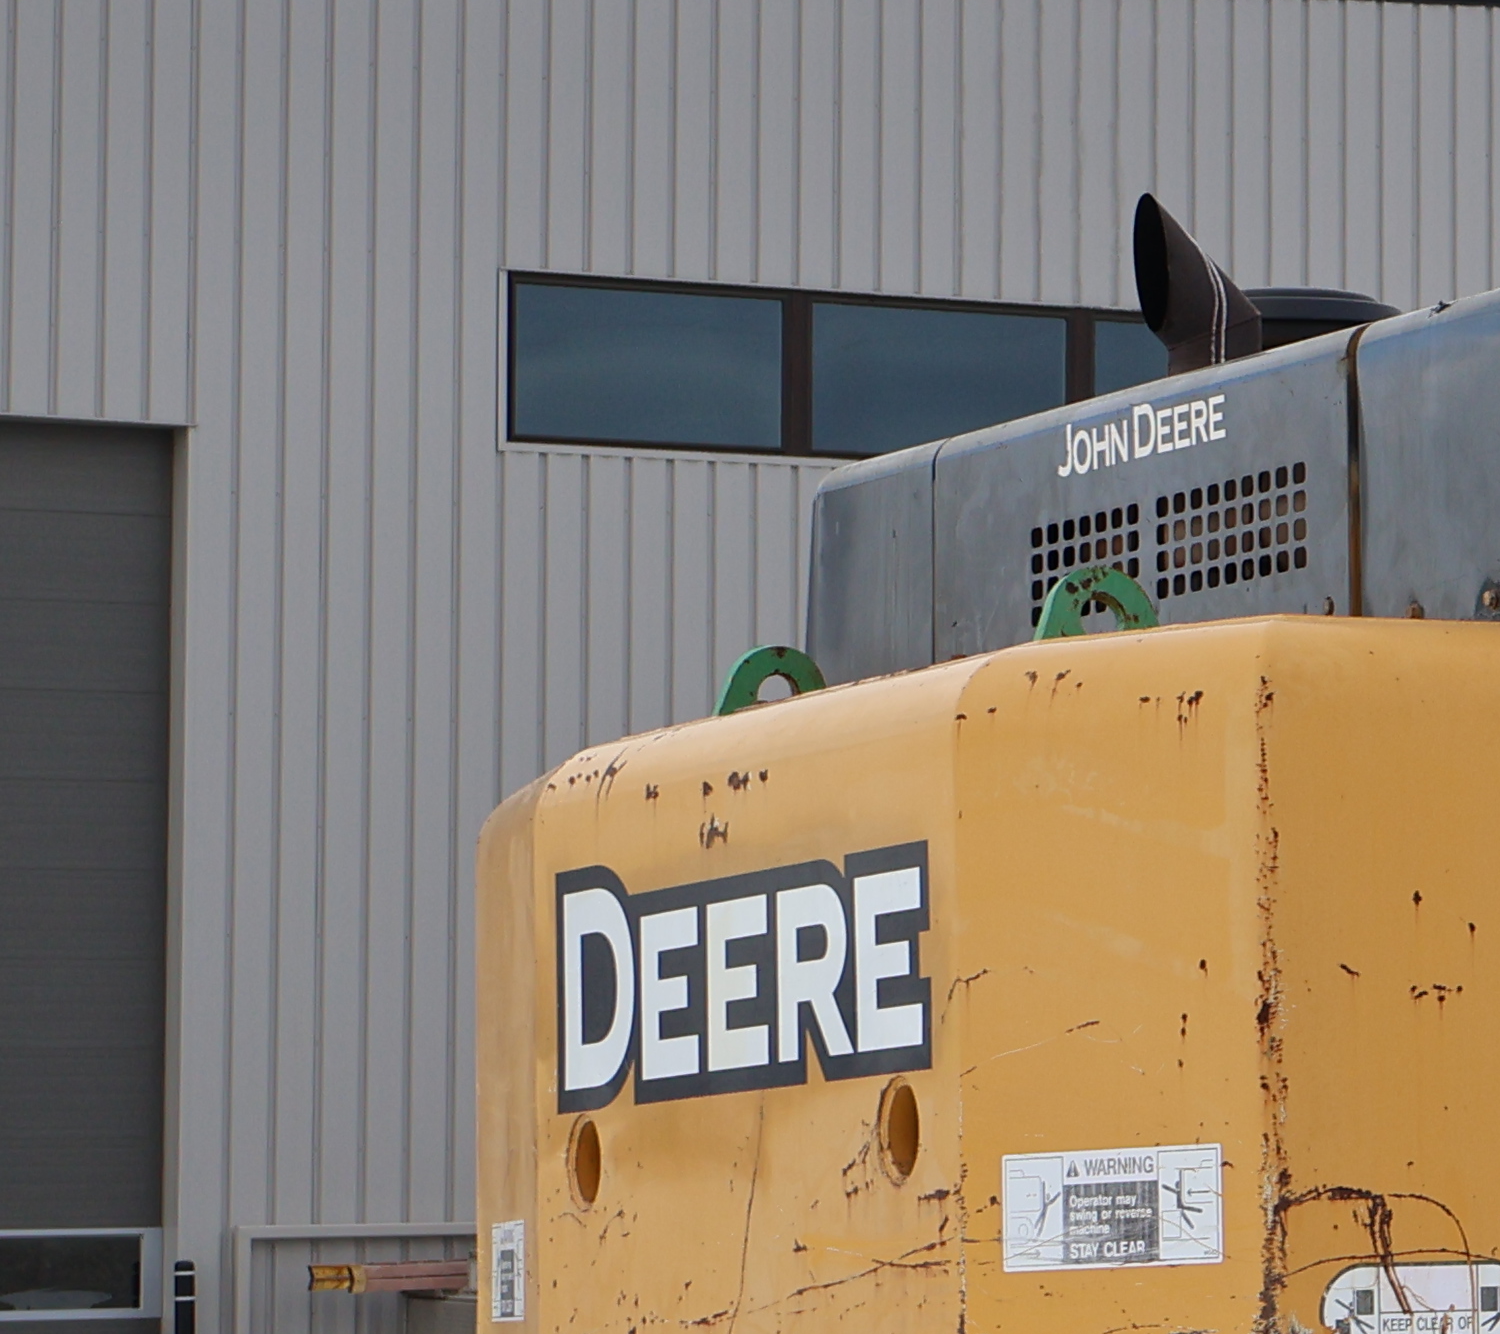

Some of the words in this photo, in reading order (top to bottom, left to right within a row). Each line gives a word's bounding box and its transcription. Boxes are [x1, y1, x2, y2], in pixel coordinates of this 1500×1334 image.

[1057, 420, 1129, 477] JOHN
[1132, 394, 1226, 459] DEERE
[563, 866, 924, 1091] DEERE
[1084, 1156, 1155, 1177] WARNING
[1069, 1194, 1112, 1208] Operator
[1116, 1194, 1137, 1207] may
[1069, 1210, 1099, 1222] swing
[1101, 1209, 1112, 1219] or
[1114, 1207, 1153, 1218] reverse
[1069, 1223, 1110, 1237] machine
[1069, 1242, 1099, 1260] STAY
[1104, 1241, 1146, 1258] CLEAR
[1382, 1317, 1412, 1332] KEEP
[1457, 1315, 1474, 1329] OF
